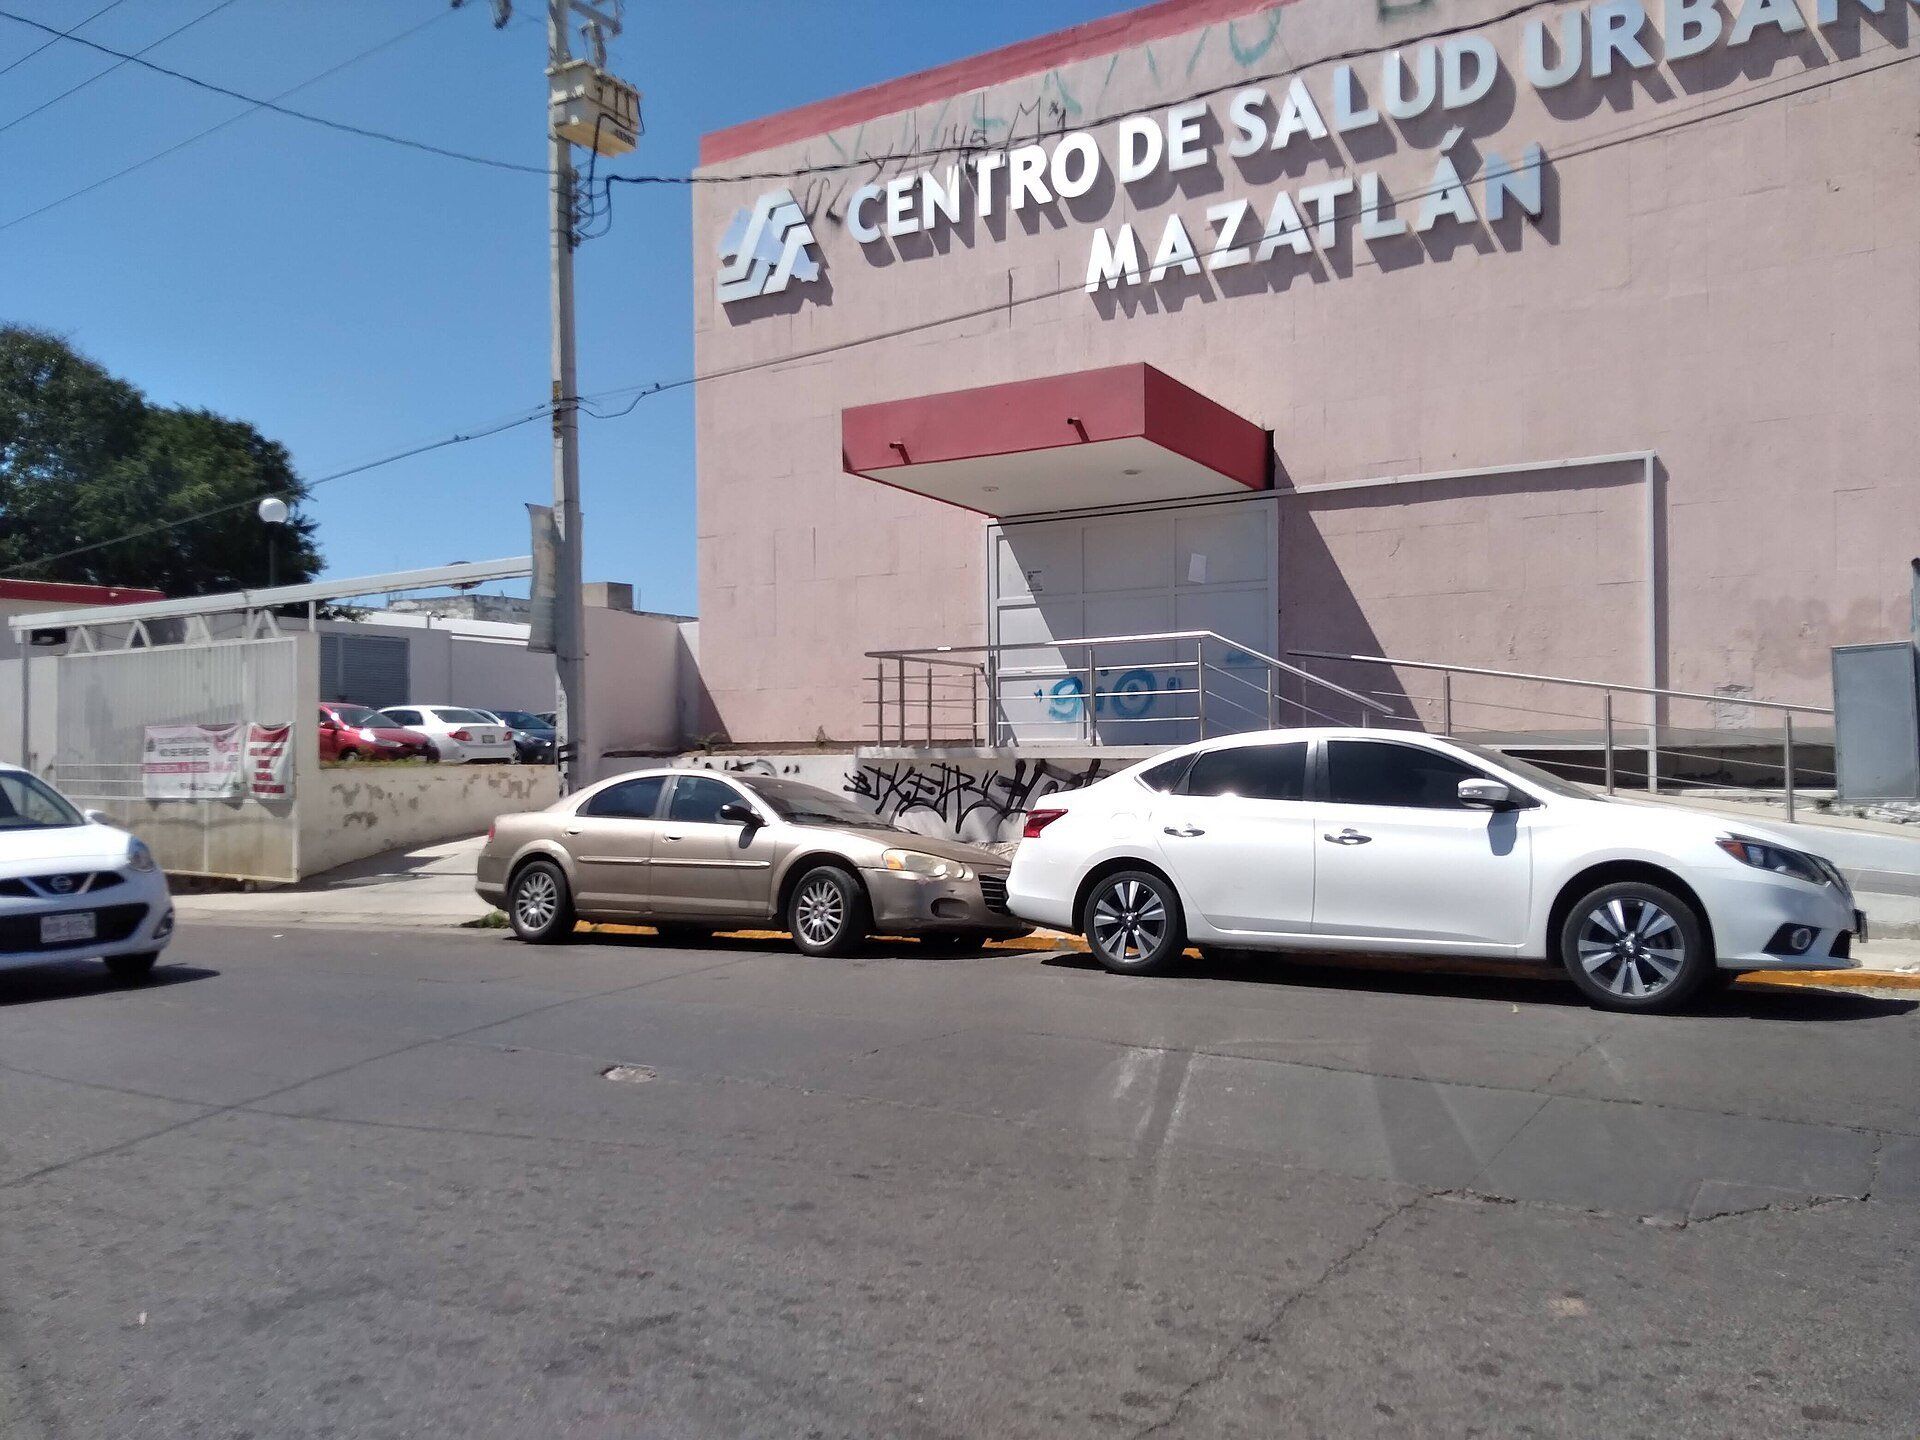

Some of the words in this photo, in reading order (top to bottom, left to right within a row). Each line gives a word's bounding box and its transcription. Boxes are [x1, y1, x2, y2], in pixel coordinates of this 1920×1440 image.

[847, 133, 1101, 245] CENTRO
[1116, 104, 1210, 184] DE
[1228, 36, 1498, 159] SALUD
[1084, 126, 1543, 293] MAZATLÁN
